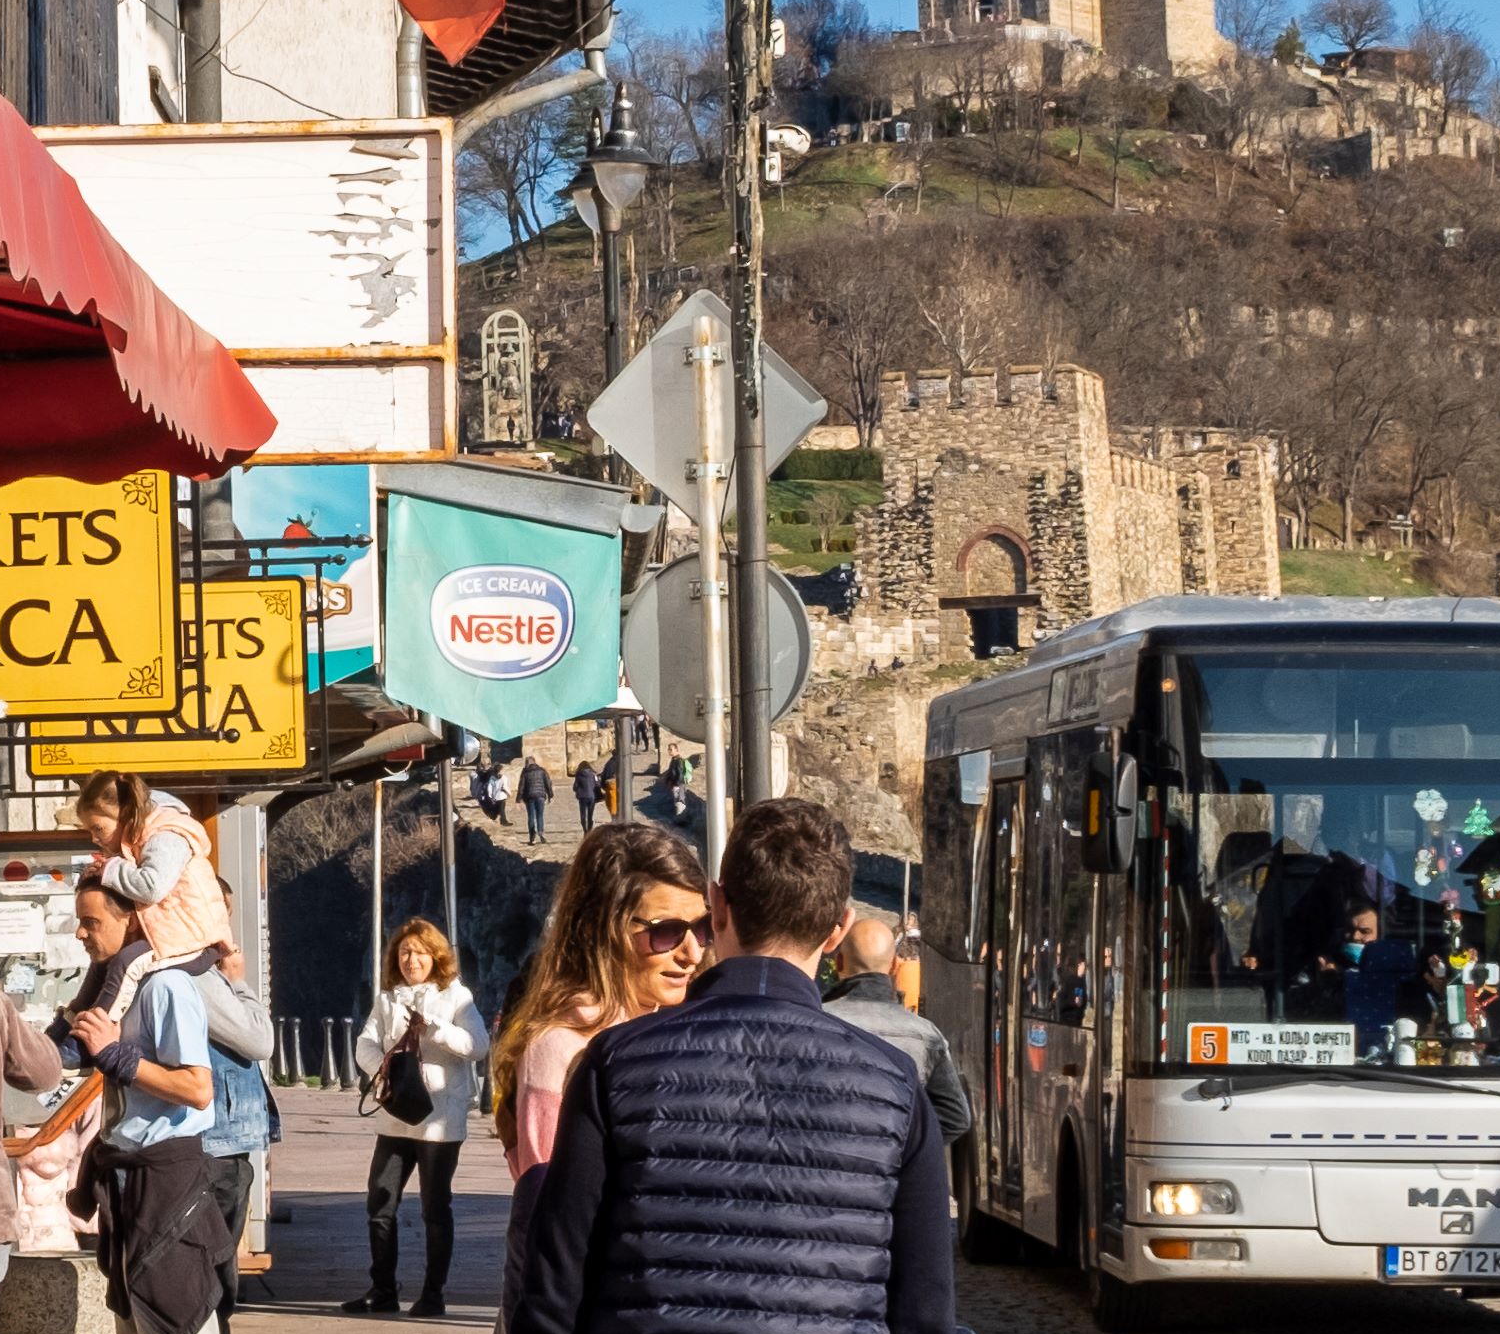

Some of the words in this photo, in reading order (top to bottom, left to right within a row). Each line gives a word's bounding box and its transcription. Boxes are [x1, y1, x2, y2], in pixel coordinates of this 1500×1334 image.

[458, 578, 482, 594] ICE
[486, 577, 547, 596] CREAM
[182, 617, 265, 660] ETS
[1202, 1032, 1216, 1059] 5
[1436, 1251, 1488, 1273] 8712
